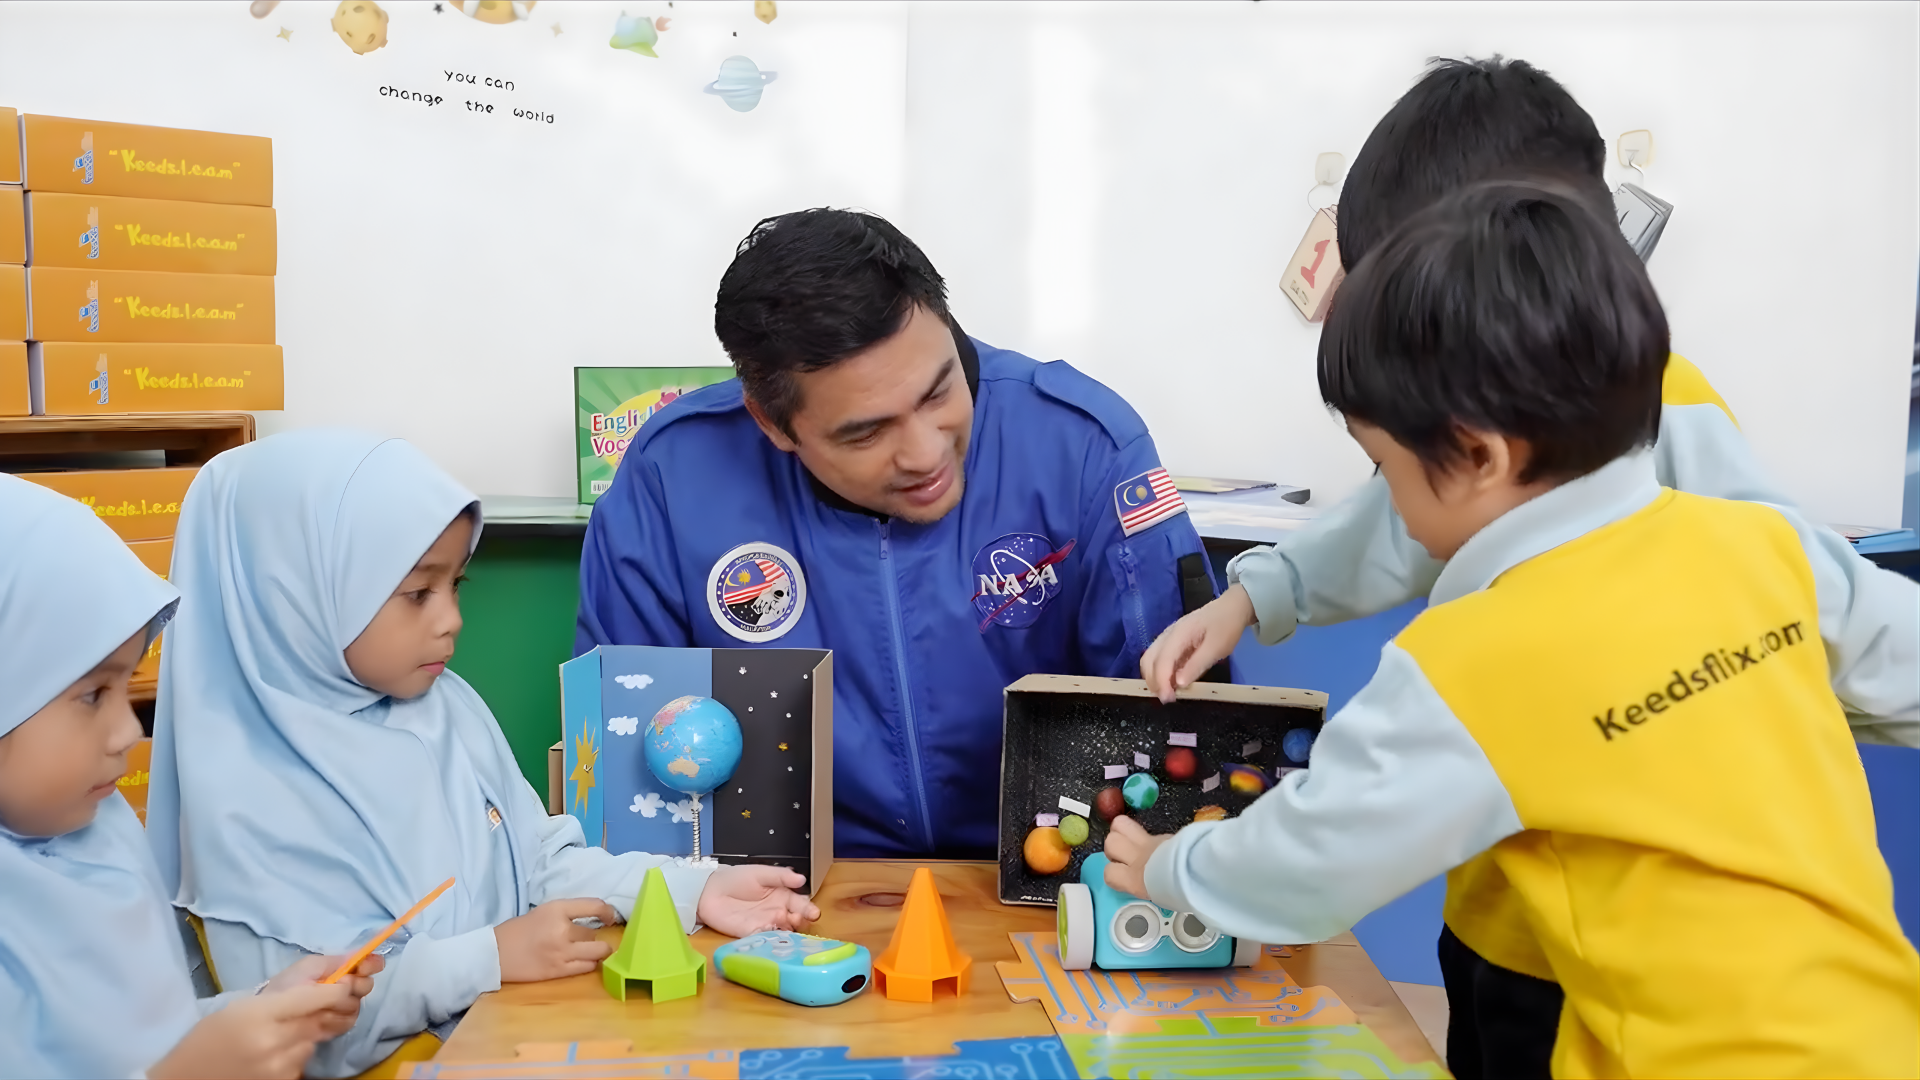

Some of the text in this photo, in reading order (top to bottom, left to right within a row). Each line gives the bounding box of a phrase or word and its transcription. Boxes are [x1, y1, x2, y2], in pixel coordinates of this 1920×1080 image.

[444, 70, 515, 92] you can
[379, 85, 554, 124] change the world
[977, 563, 1059, 597] NASA
[1591, 620, 1805, 743] Keedsflix.com
